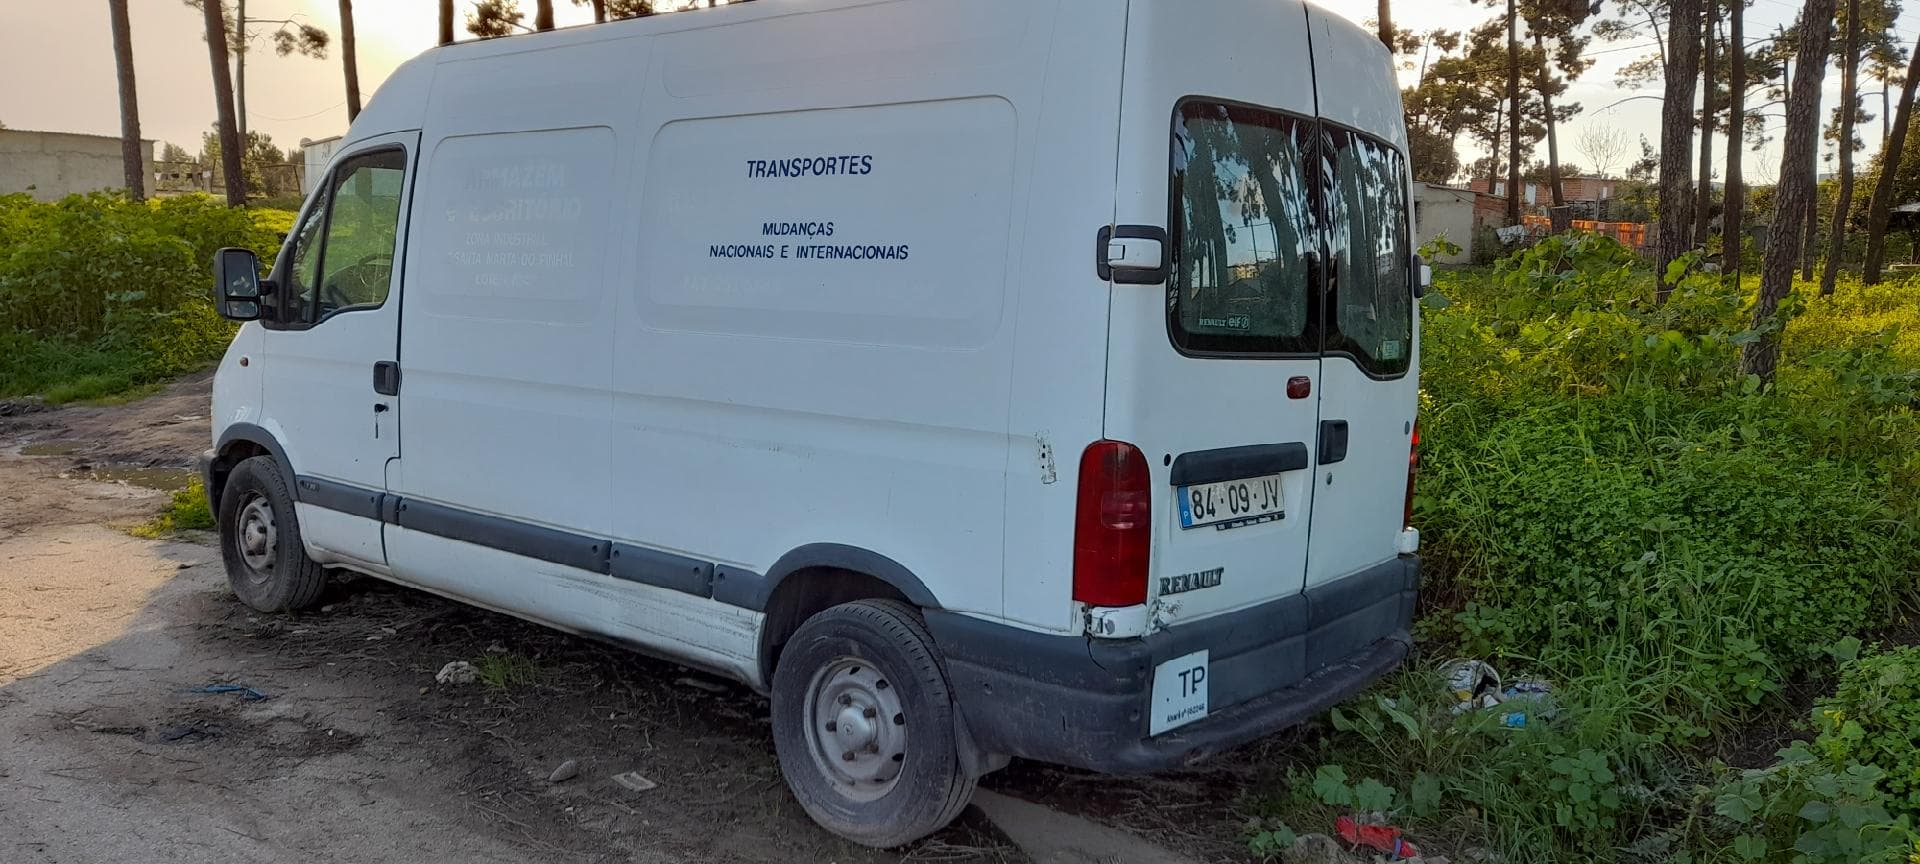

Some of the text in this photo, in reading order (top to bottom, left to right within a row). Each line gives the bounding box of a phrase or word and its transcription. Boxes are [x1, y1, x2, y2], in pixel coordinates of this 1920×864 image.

[747, 155, 873, 178] TRANSPORTES
[762, 221, 834, 240] MUDANÇAS
[709, 244, 909, 260] NACIONAIS E INTERNACIONAIS
[1159, 567, 1225, 596] RENAULT
[1178, 666, 1206, 698] TP
